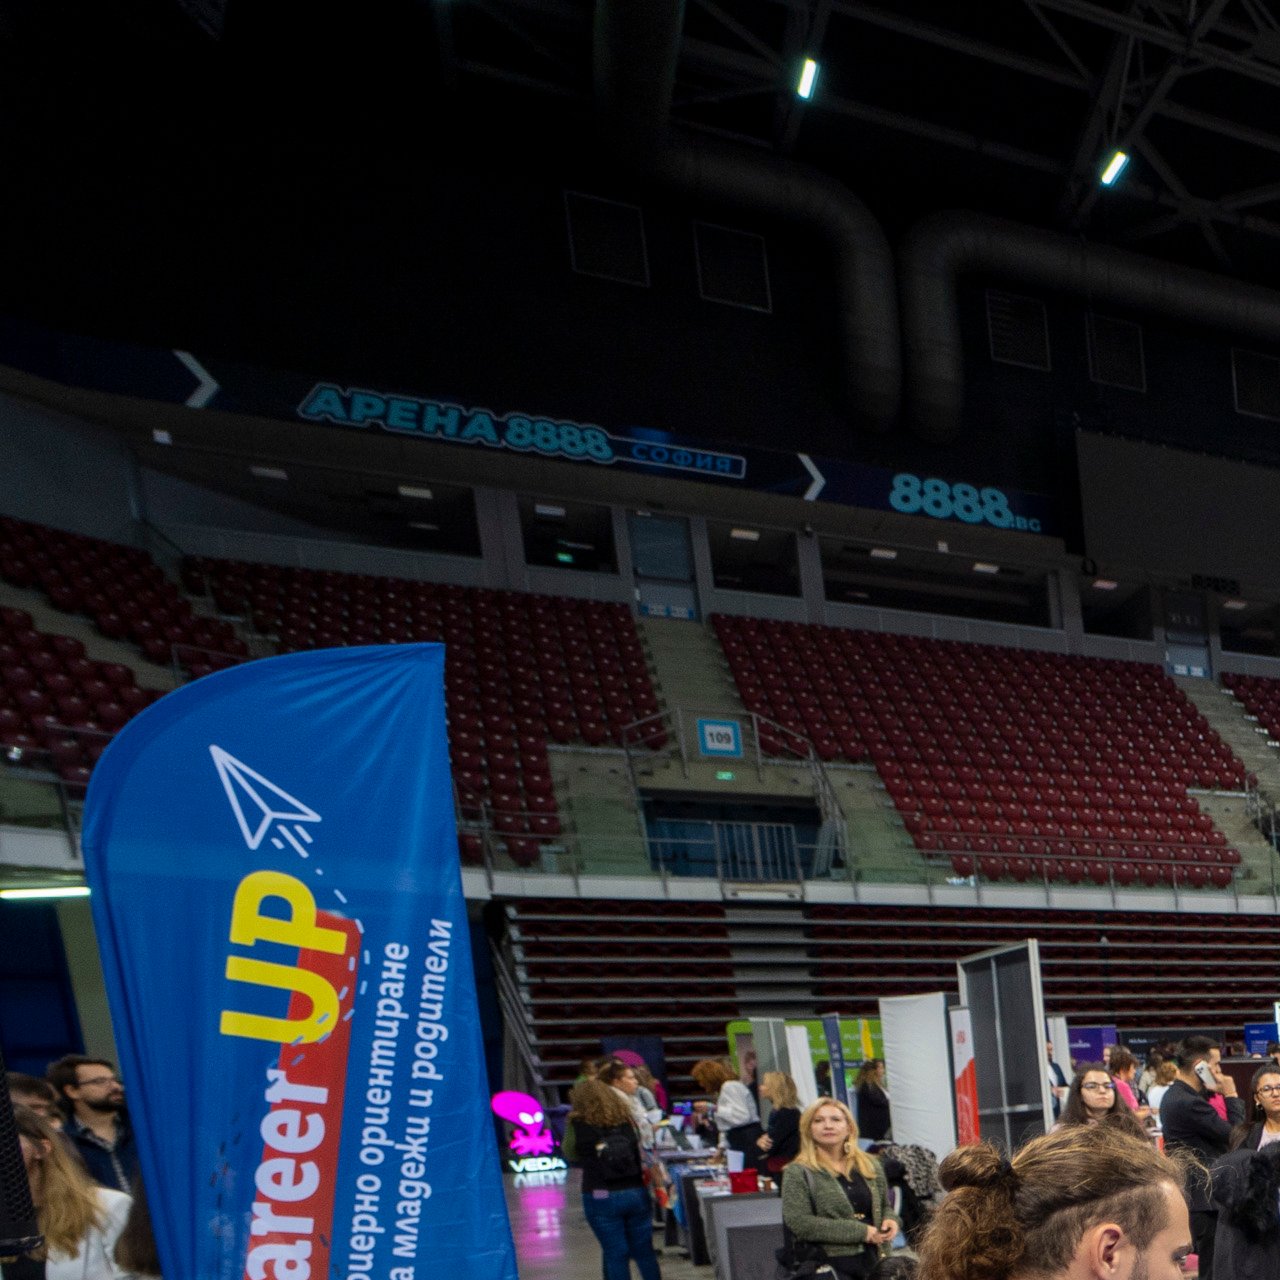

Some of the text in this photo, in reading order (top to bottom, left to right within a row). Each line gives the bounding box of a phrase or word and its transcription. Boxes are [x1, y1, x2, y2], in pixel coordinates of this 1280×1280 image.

[301, 386, 731, 472] АРЕНА 8888 СОФИЯ
[709, 732, 732, 744] 109
[218, 870, 348, 1046] UP
[411, 918, 453, 1081] родители
[359, 942, 411, 1166] ориентиране
[408, 1088, 434, 1108] и
[392, 1116, 433, 1258] младежи
[508, 1156, 568, 1173] VEDA
